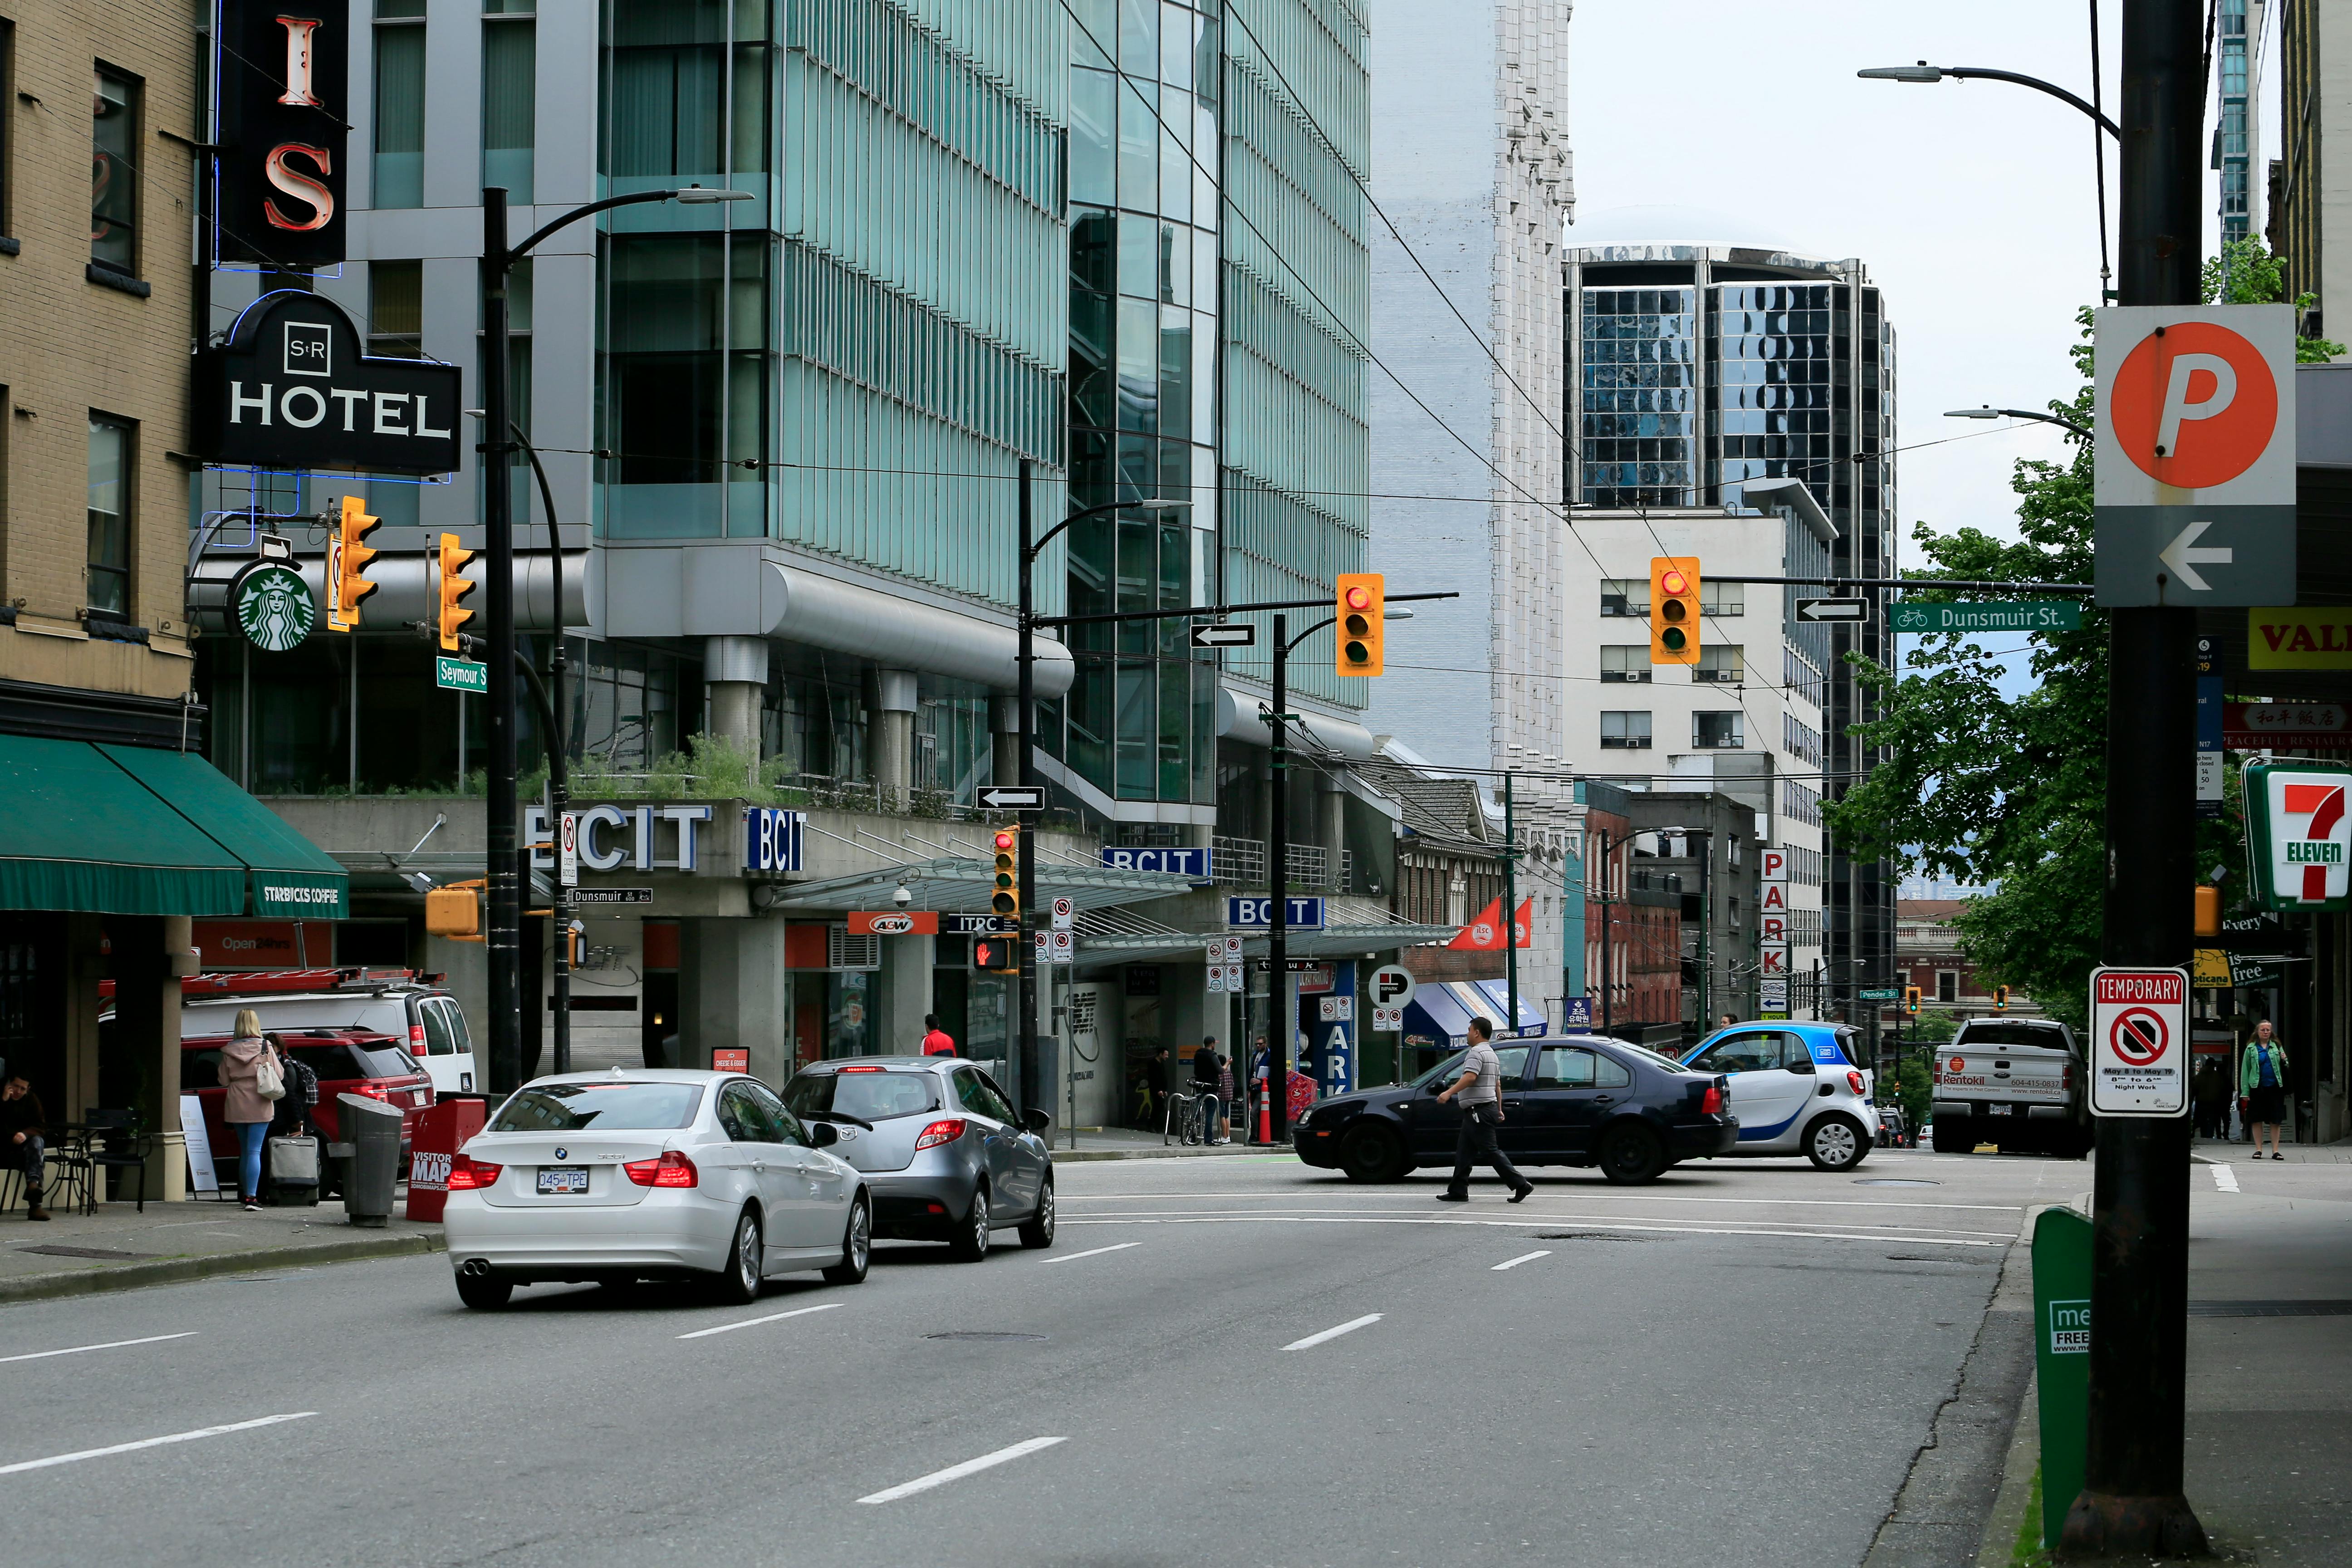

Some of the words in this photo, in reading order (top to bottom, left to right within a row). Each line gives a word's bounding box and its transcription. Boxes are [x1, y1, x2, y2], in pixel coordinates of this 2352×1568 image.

[290, 340, 325, 358] StR
[230, 381, 451, 439] HOTEL
[2155, 353, 2237, 457] P
[1942, 608, 2034, 627] Dunsmuir
[2039, 607, 2065, 626] St.
[441, 661, 478, 685] Seymour
[481, 667, 486, 686] S
[2256, 709, 2335, 726] 和平飯店
[760, 808, 807, 871] BCIT
[2284, 785, 2345, 900] 7
[1114, 851, 1192, 873] BCIT
[575, 891, 622, 901] Dunsmuir
[1239, 900, 1308, 923] BCT
[1764, 853, 1784, 973] PARK
[876, 921, 909, 930] A&W
[960, 917, 997, 931] ITPC
[2228, 951, 2241, 965] is
[2233, 966, 2262, 982] free
[2101, 978, 2180, 1000] TEMPORARY
[1568, 1015, 1589, 1024] 유학원
[1325, 1026, 1348, 1097] ARK
[1944, 1075, 1984, 1085] Rentokil
[2011, 1079, 2059, 1088] 604-415-0837
[413, 1152, 451, 1163] VISITOR
[411, 1161, 451, 1182] MAP
[539, 1174, 559, 1186] 045
[567, 1173, 586, 1186] TPE
[2058, 1309, 2090, 1326] me
[2056, 1332, 2089, 1344] FREE
